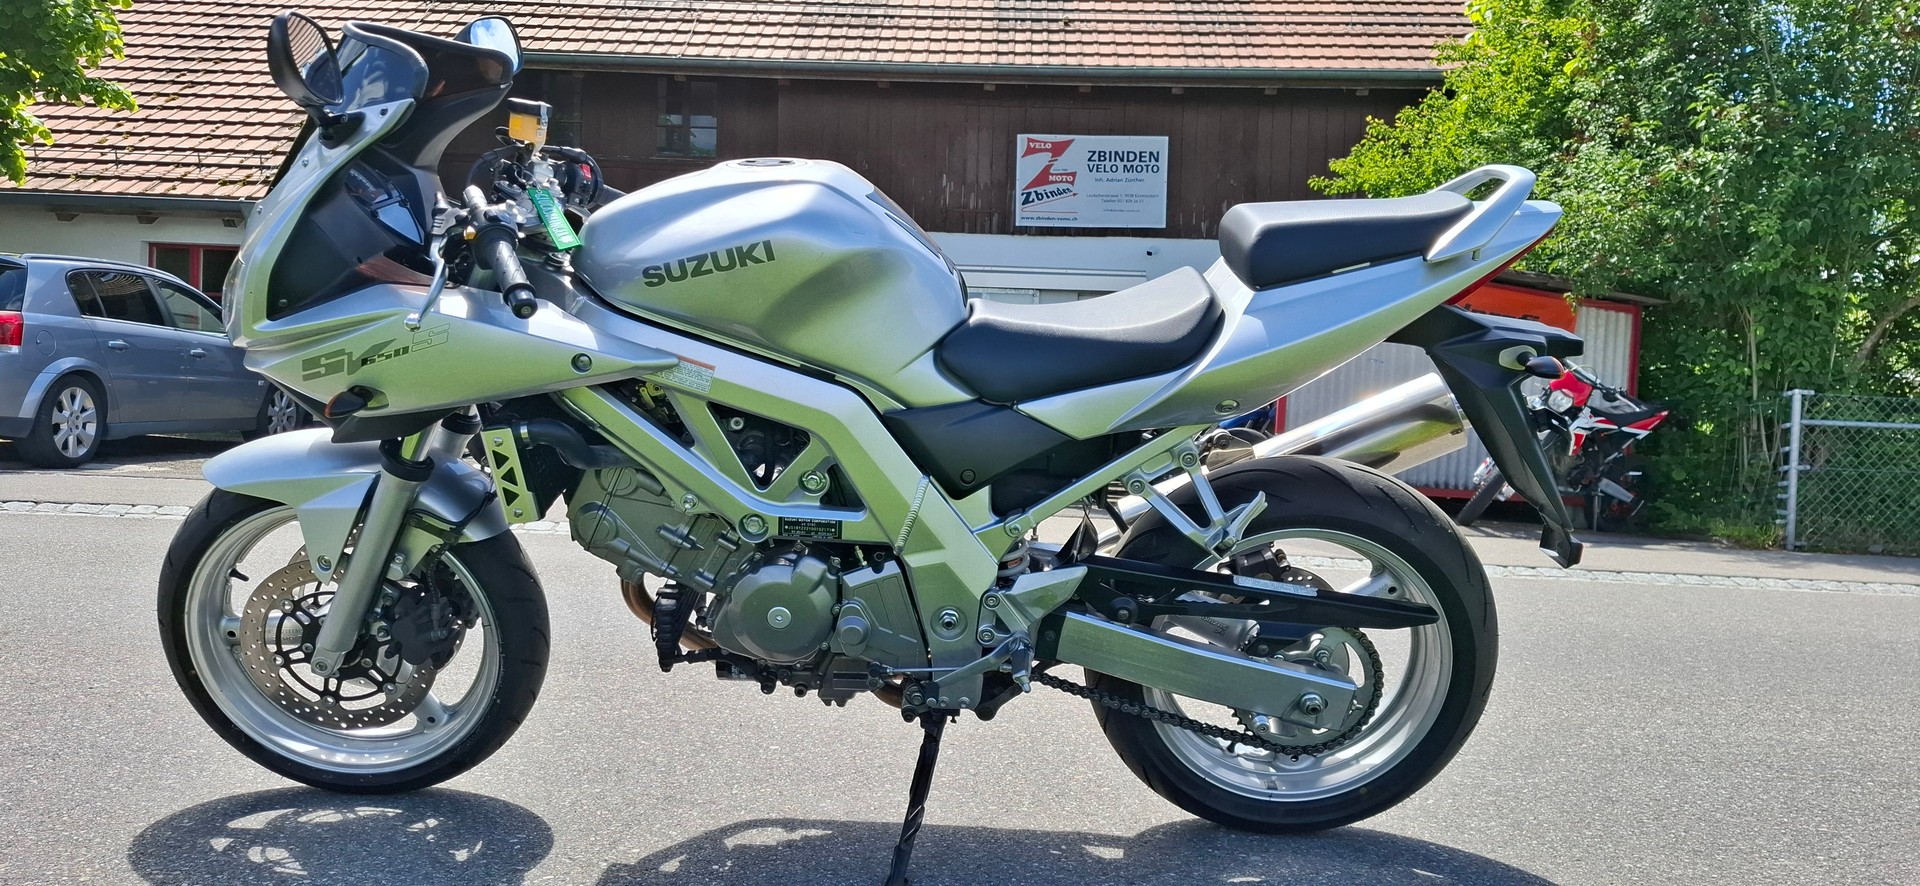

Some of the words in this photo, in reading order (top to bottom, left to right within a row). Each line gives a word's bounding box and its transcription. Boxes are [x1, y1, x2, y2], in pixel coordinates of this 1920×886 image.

[1087, 150, 1160, 163] ZBINDEN
[1087, 164, 1119, 174] VELO
[1123, 164, 1160, 174] MOTO
[1021, 187, 1074, 206] Zbinden
[641, 239, 776, 288] SUZUKI
